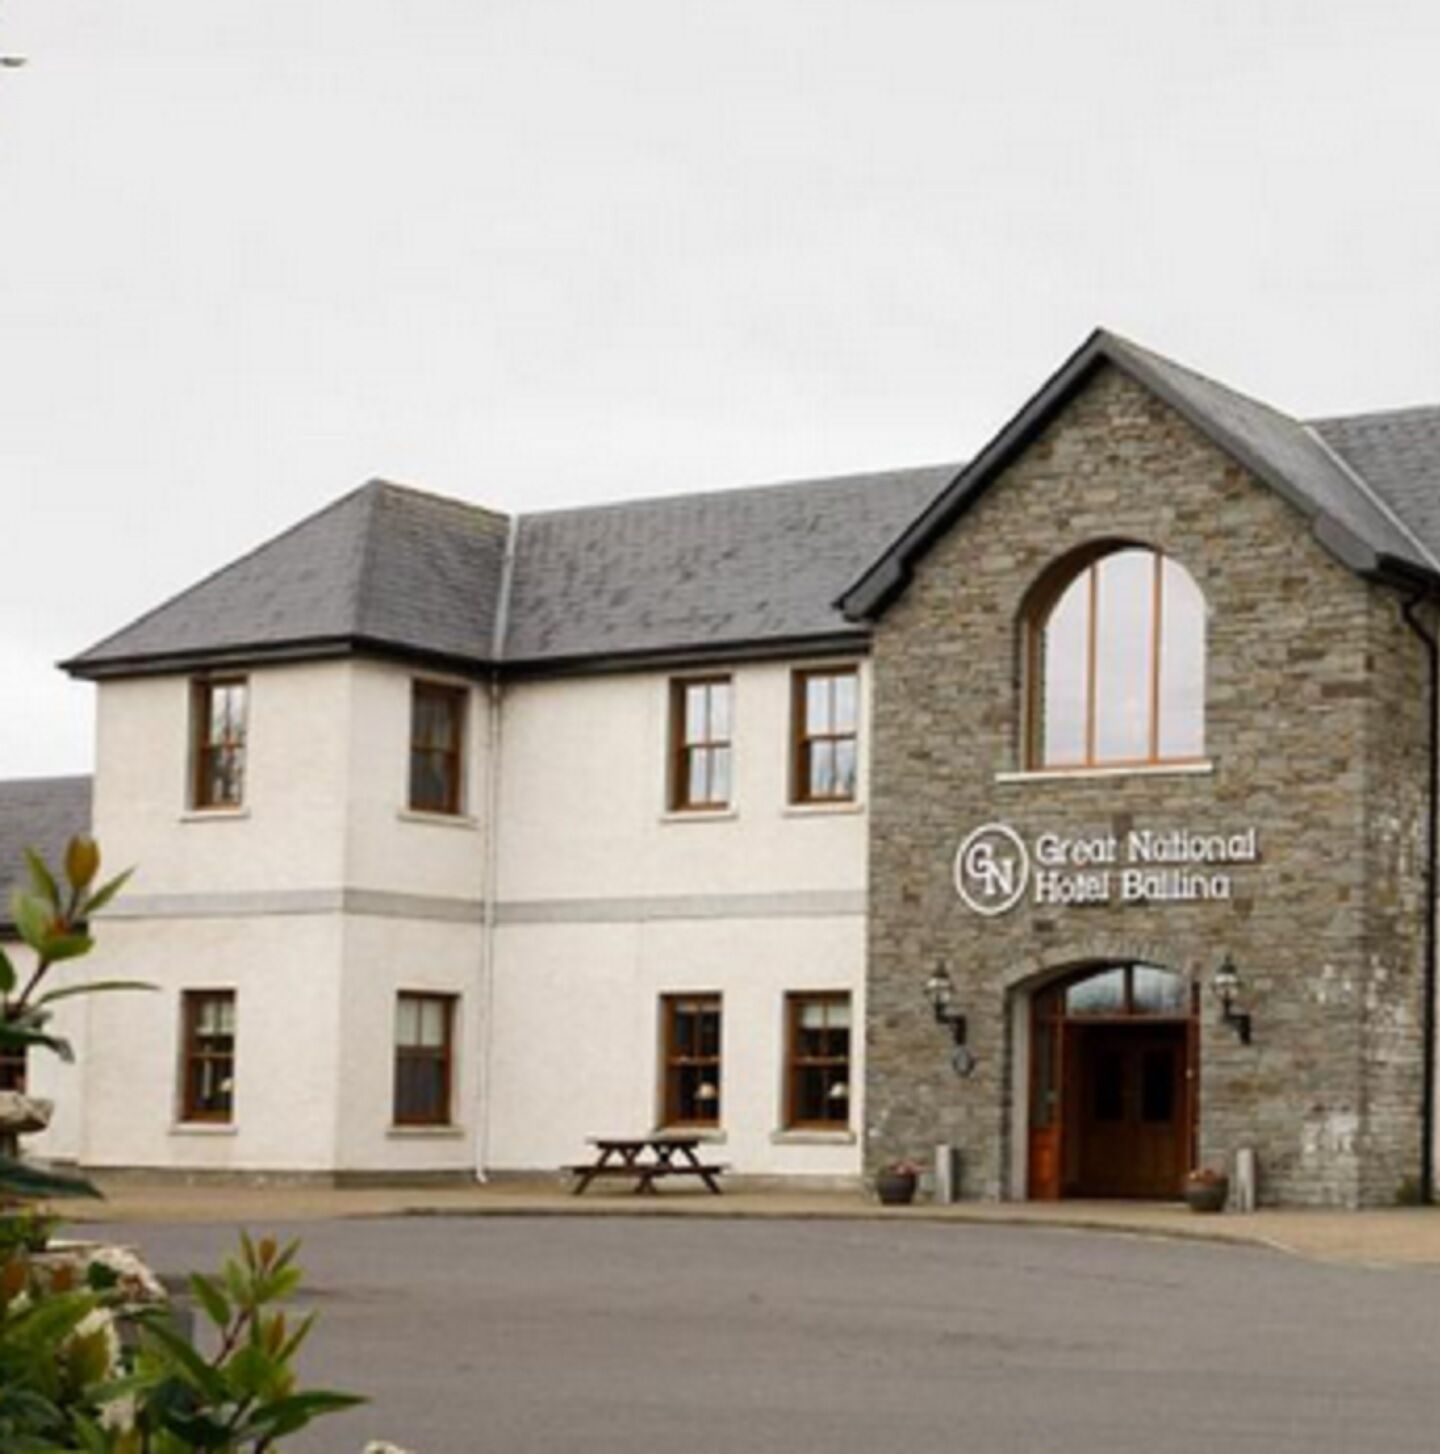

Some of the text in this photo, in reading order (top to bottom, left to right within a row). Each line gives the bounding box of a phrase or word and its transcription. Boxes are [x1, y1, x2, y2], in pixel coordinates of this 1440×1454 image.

[1035, 827, 1258, 865] Great National
[1034, 868, 1230, 902] Hotel Ballina
